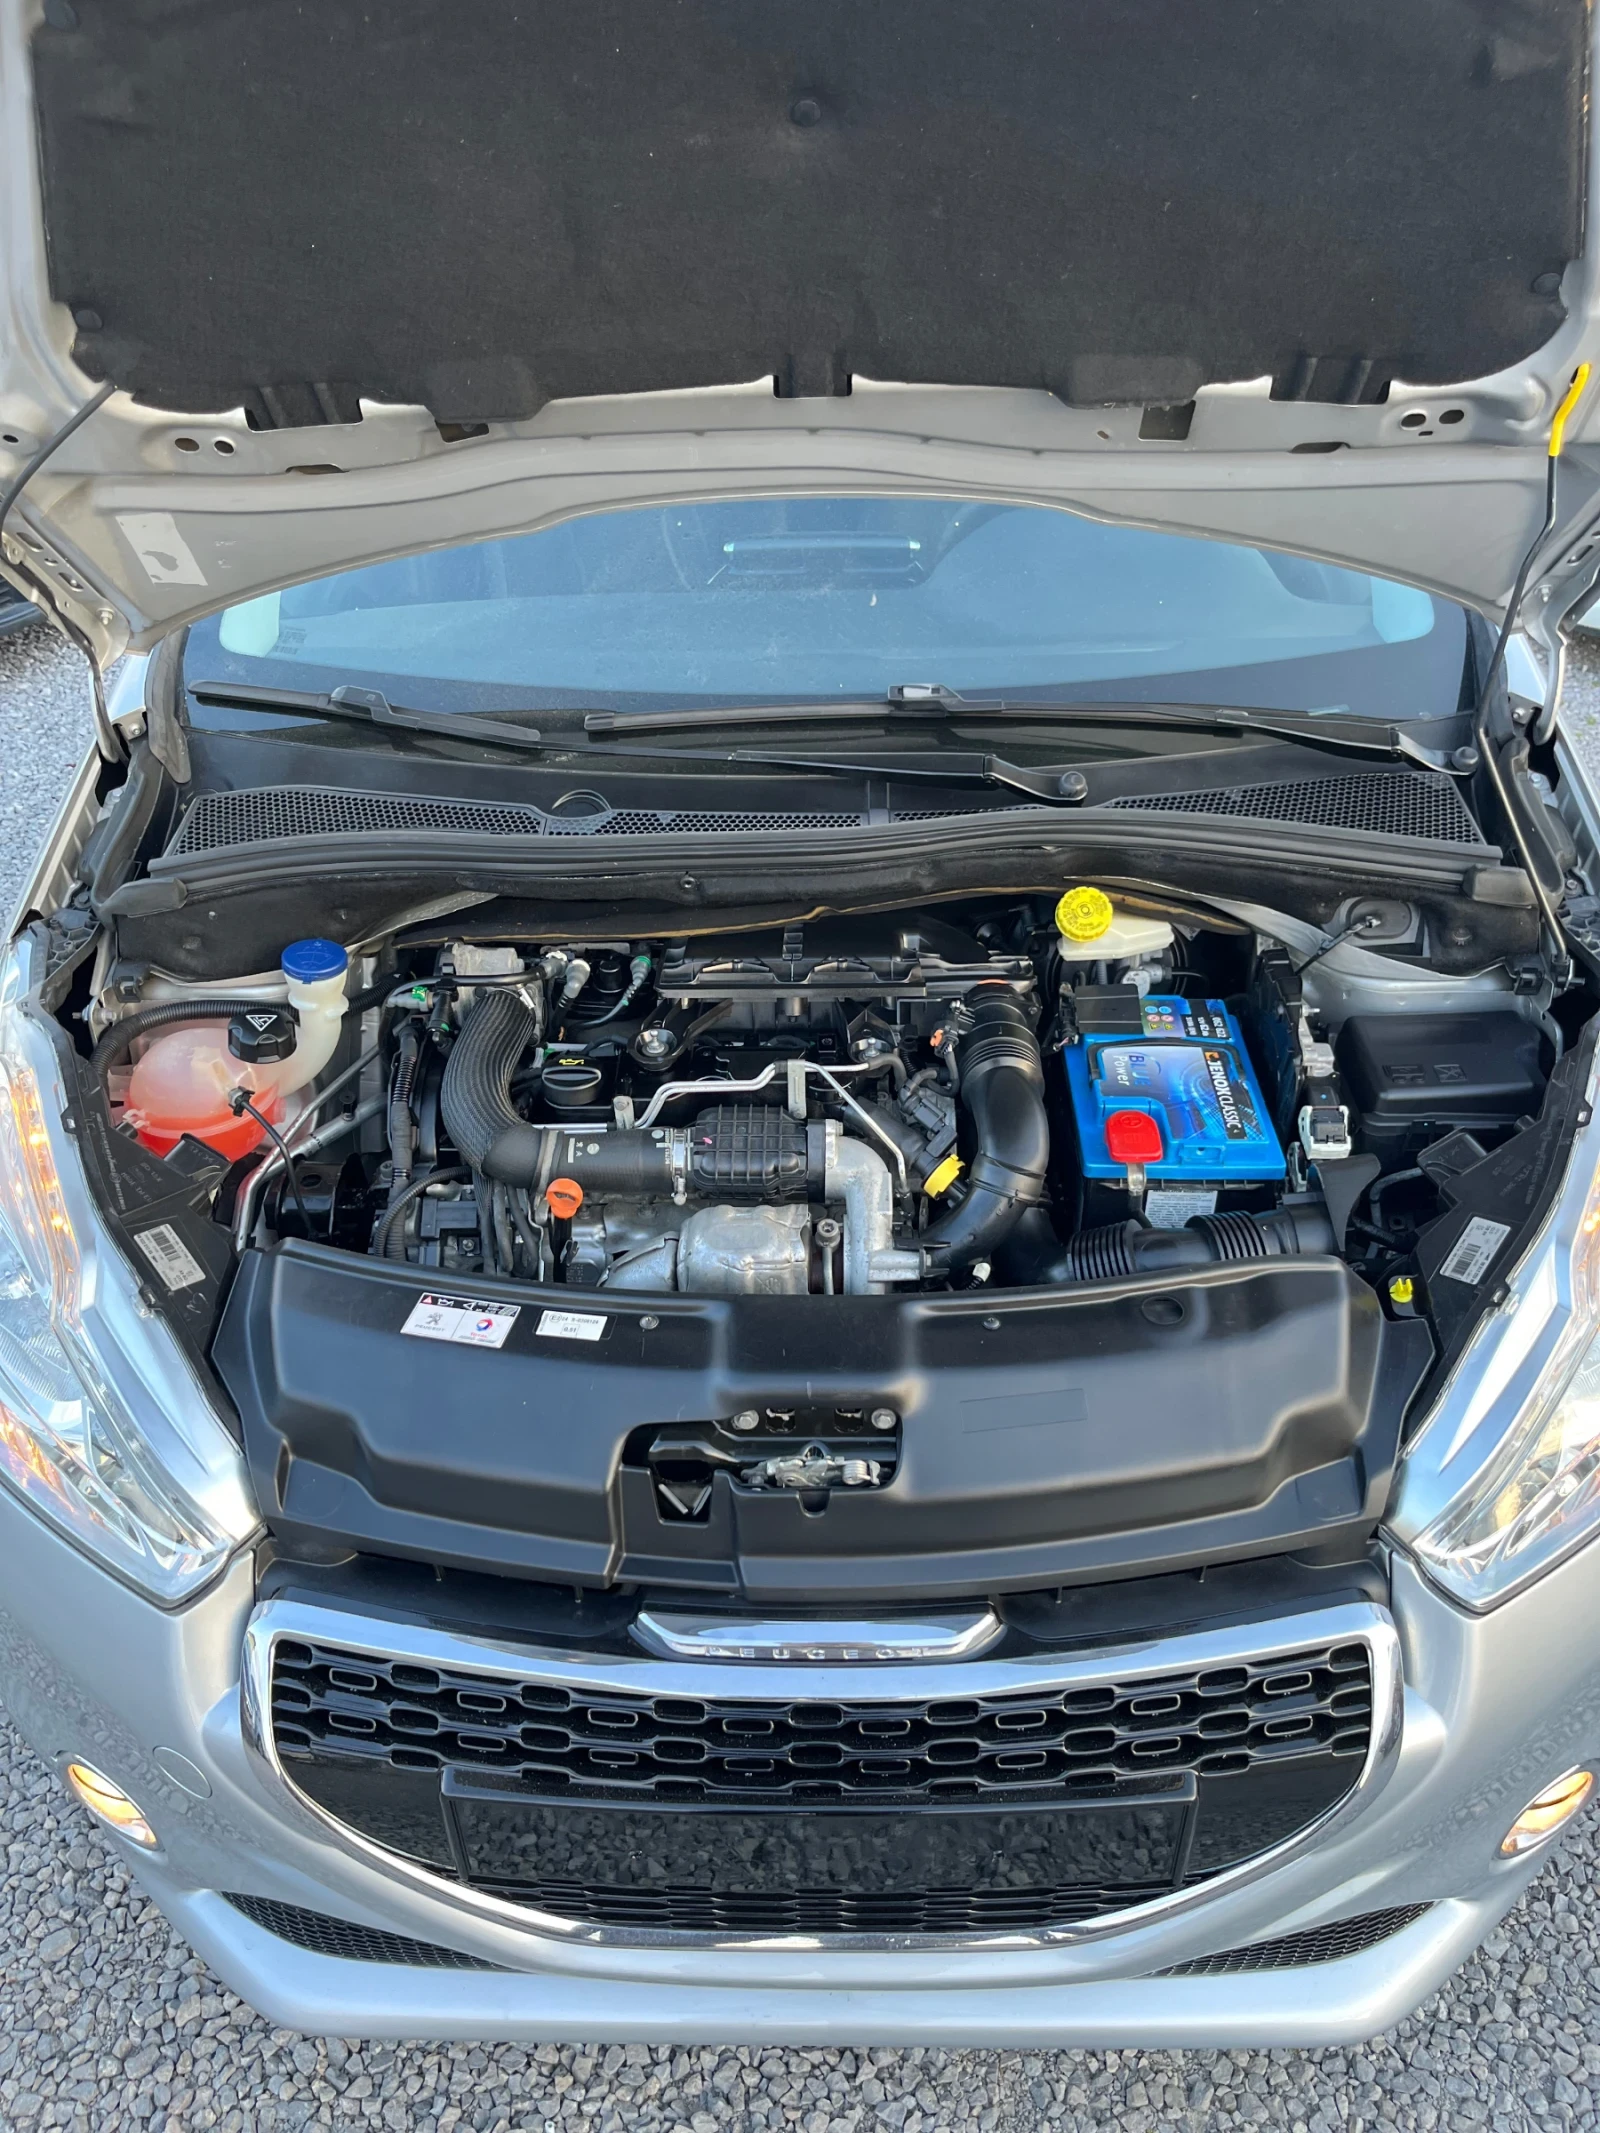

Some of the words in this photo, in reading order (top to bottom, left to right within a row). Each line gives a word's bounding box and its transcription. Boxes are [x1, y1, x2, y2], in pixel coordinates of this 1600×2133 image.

[1112, 1054, 1130, 1086] Power
[1129, 1054, 1151, 1086] BLUE
[414, 1323, 446, 1333] PEUGEOT
[704, 1645, 929, 1660] PEUGEOT
